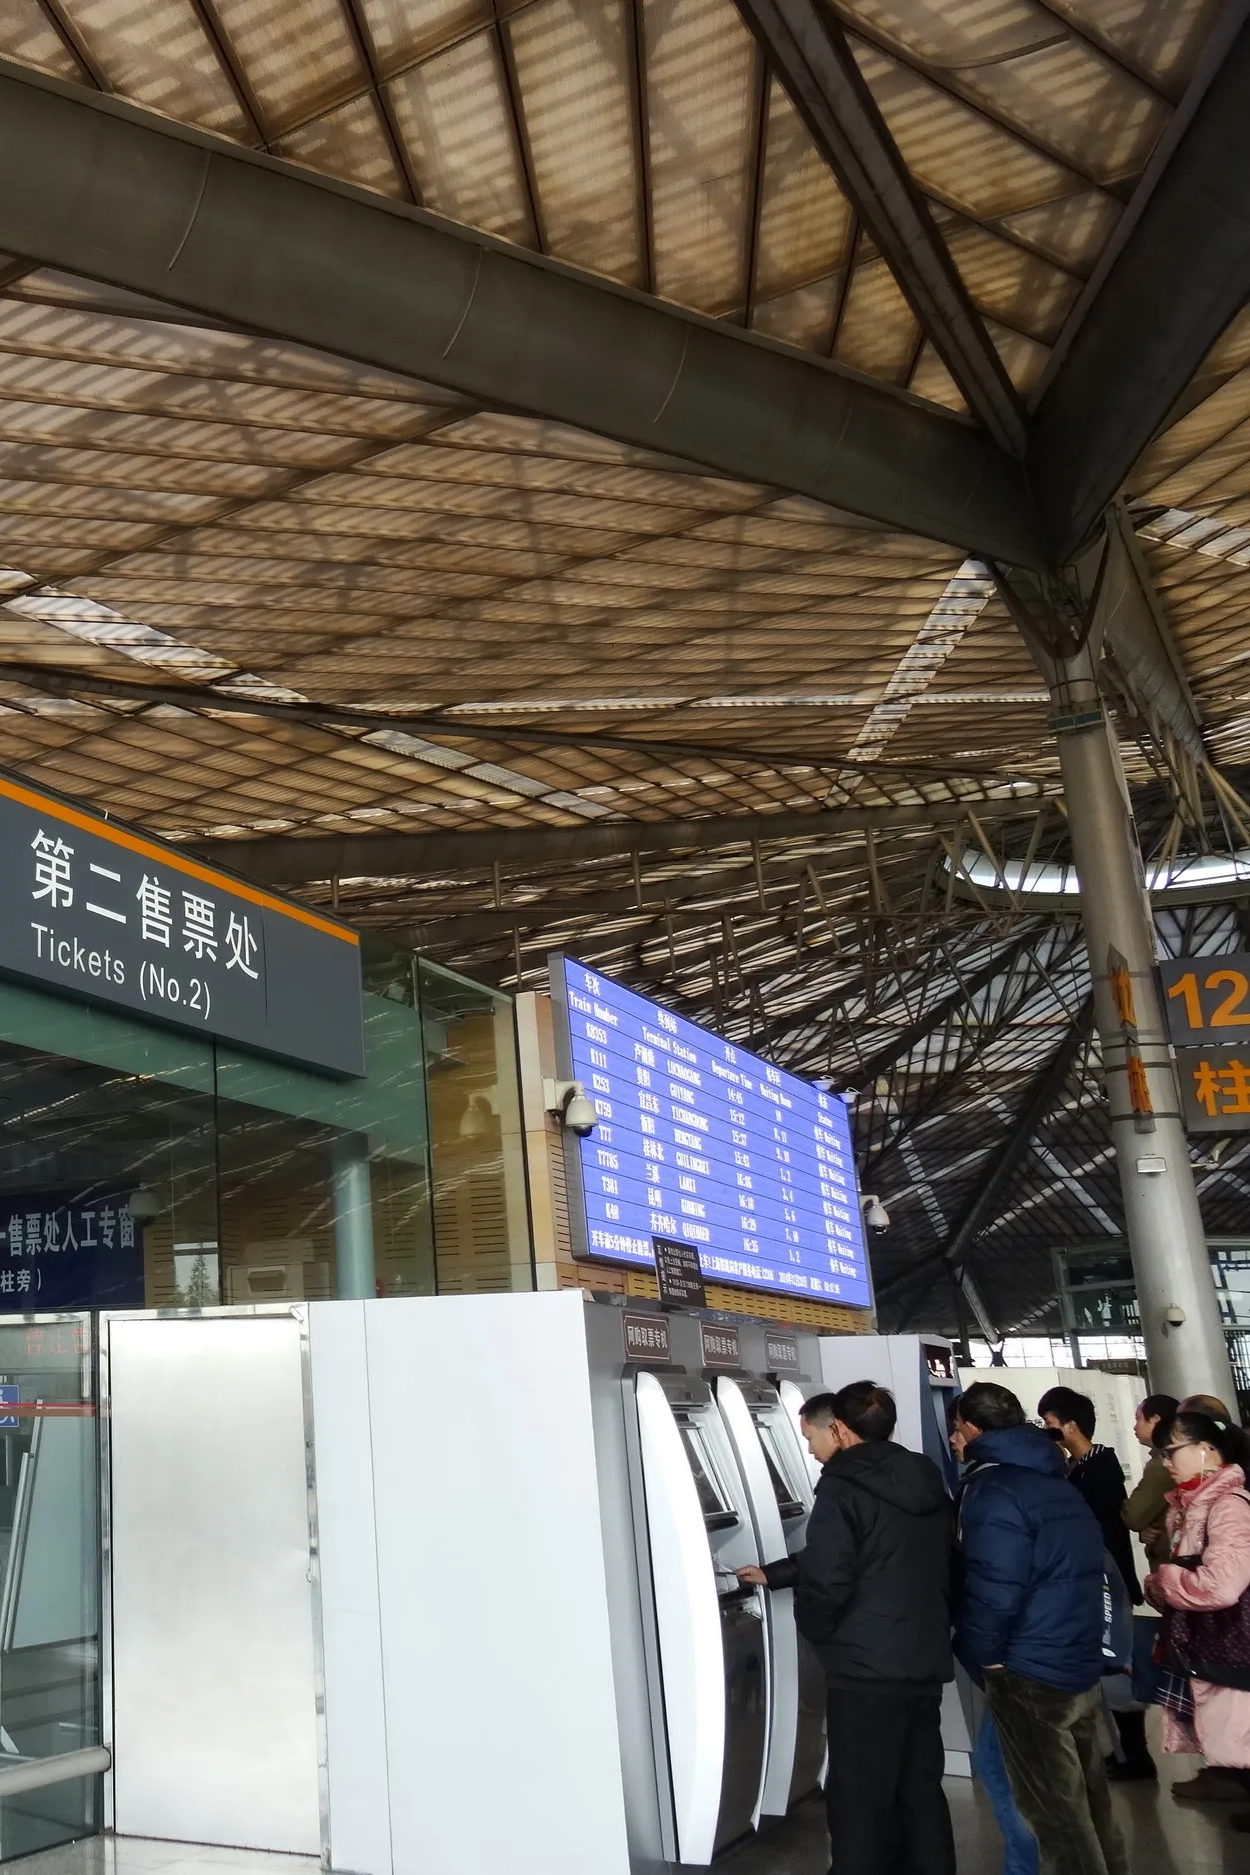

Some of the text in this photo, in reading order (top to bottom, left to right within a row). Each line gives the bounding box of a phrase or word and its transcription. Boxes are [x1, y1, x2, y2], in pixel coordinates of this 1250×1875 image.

[31, 829, 258, 979] 第二售票处
[31, 922, 210, 1020] Tickets (No.2)
[1167, 970, 1250, 1029] 12
[569, 991, 591, 1014] Train
[642, 1027, 670, 1051] Terminal
[672, 1041, 696, 1063] Station
[1193, 1059, 1250, 1117] 柱
